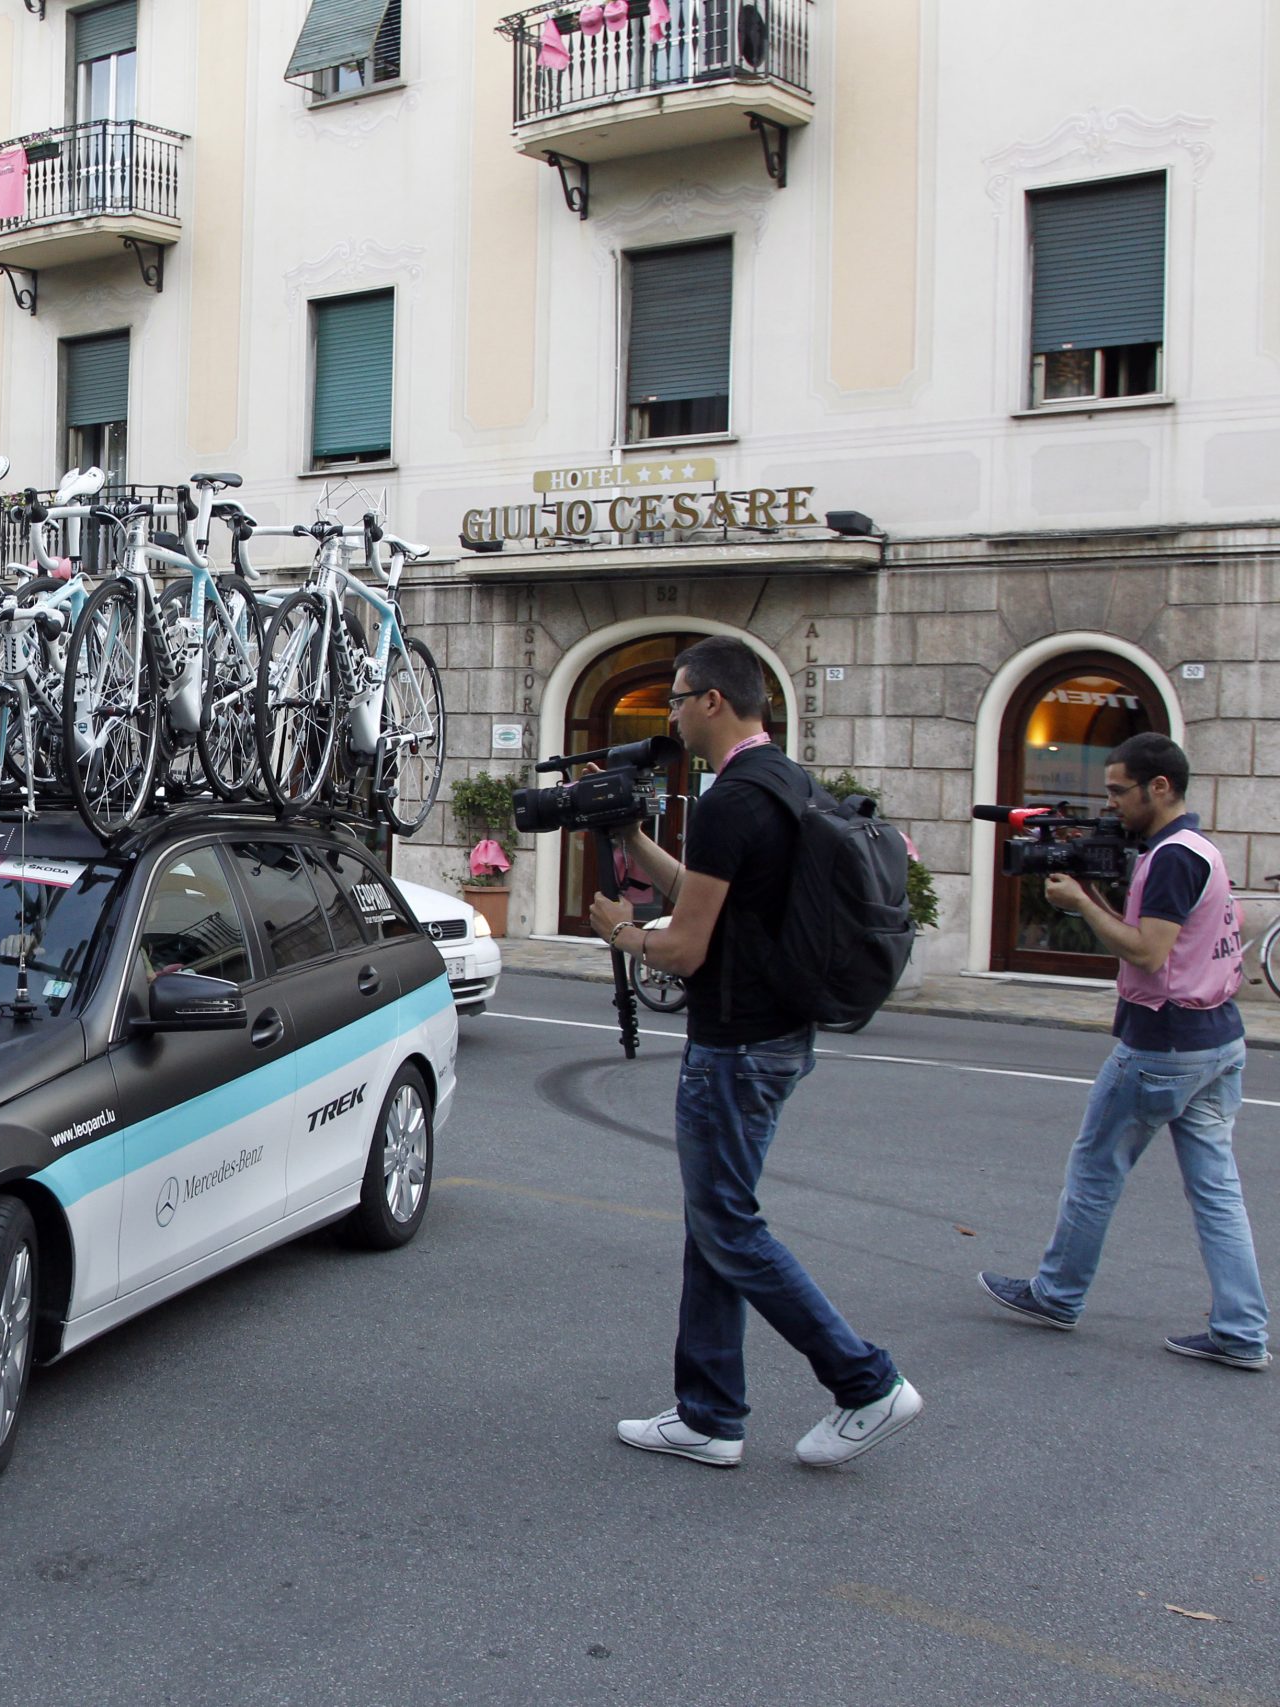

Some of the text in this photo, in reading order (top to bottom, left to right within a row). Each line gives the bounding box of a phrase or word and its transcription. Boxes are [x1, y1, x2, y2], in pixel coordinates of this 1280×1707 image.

[550, 466, 630, 490] HOTEL
[462, 486, 818, 543] GIULIO CESARE
[657, 586, 677, 601] 52
[521, 584, 535, 783] RISTORANT
[803, 622, 819, 768] ALBERG
[829, 669, 841, 679] 52
[351, 883, 392, 913] LEOPARD
[51, 1108, 116, 1147] www.leopard.lu
[307, 1081, 368, 1133] TREK
[182, 1145, 264, 1203] Mercedes-Benz
